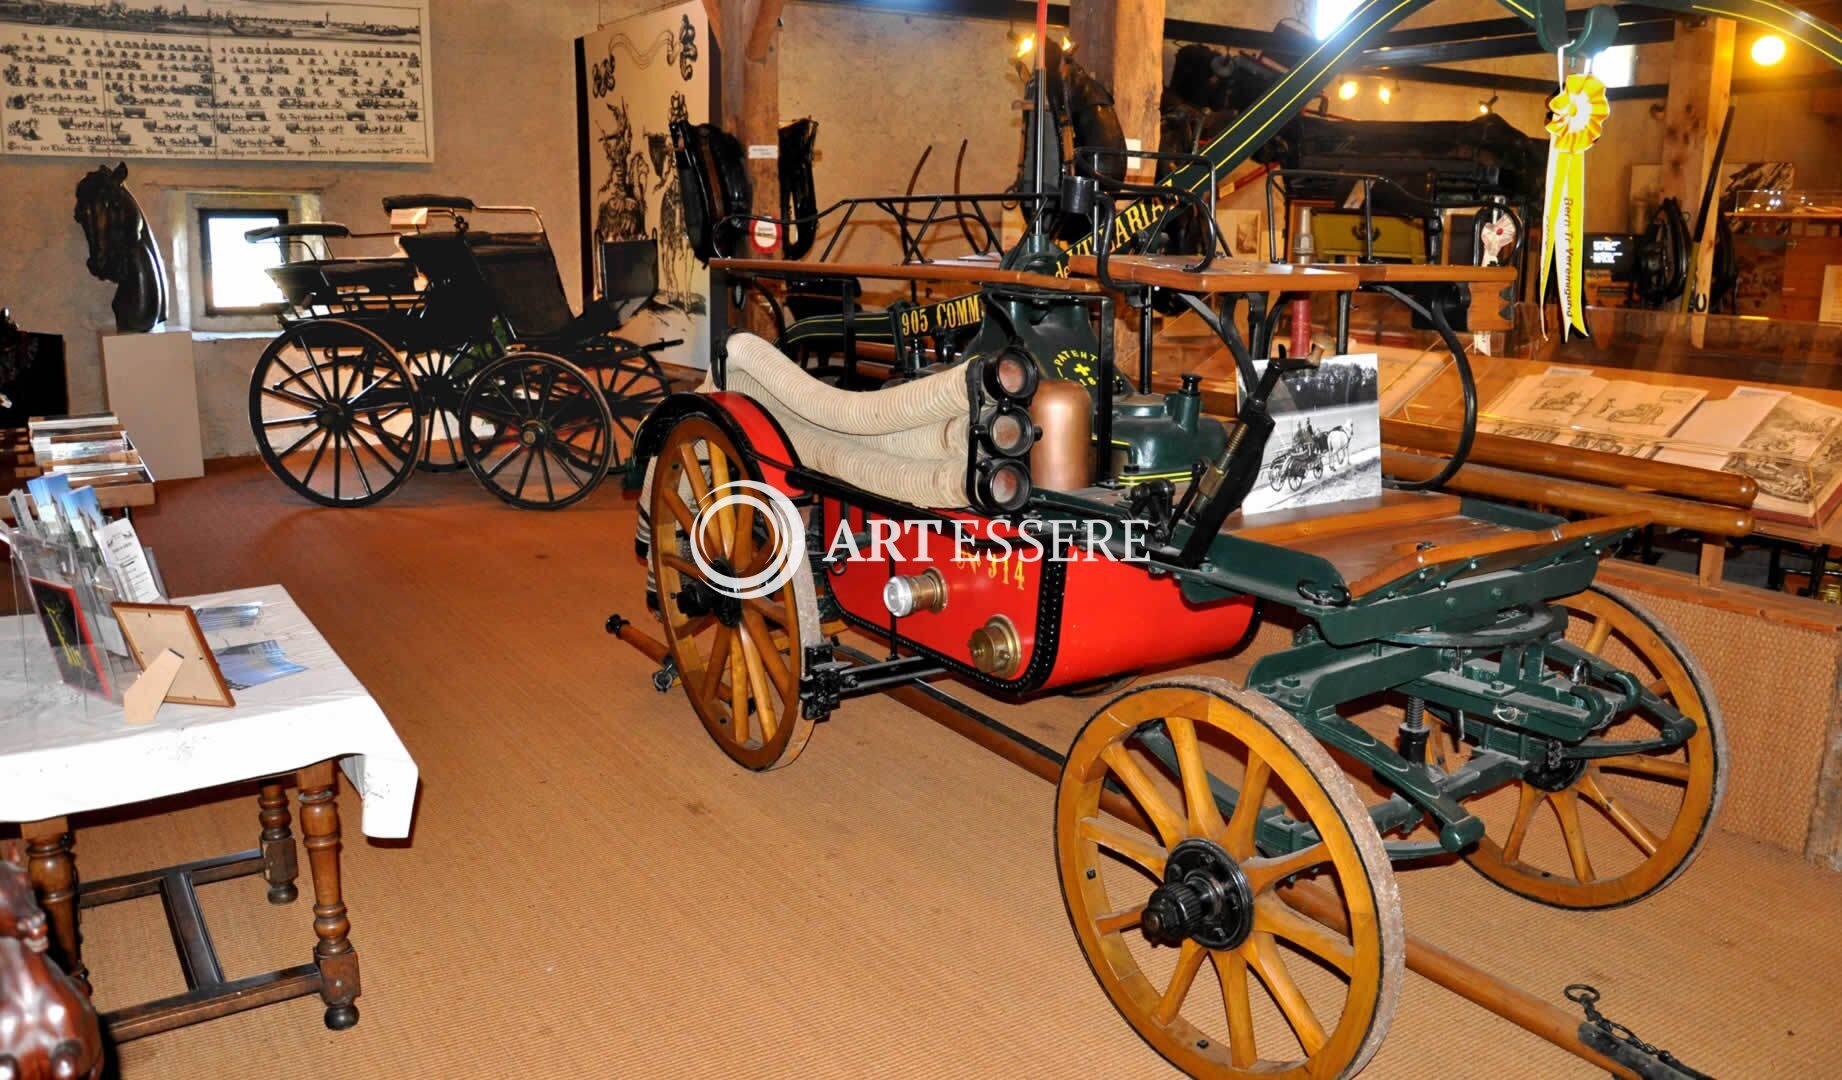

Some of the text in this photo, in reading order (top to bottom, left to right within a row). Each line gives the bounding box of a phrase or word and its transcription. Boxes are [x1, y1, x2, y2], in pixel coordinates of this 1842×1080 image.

[1564, 196, 1574, 228] Bern
[936, 295, 985, 329] COMM
[1053, 349, 1099, 367] PATENT
